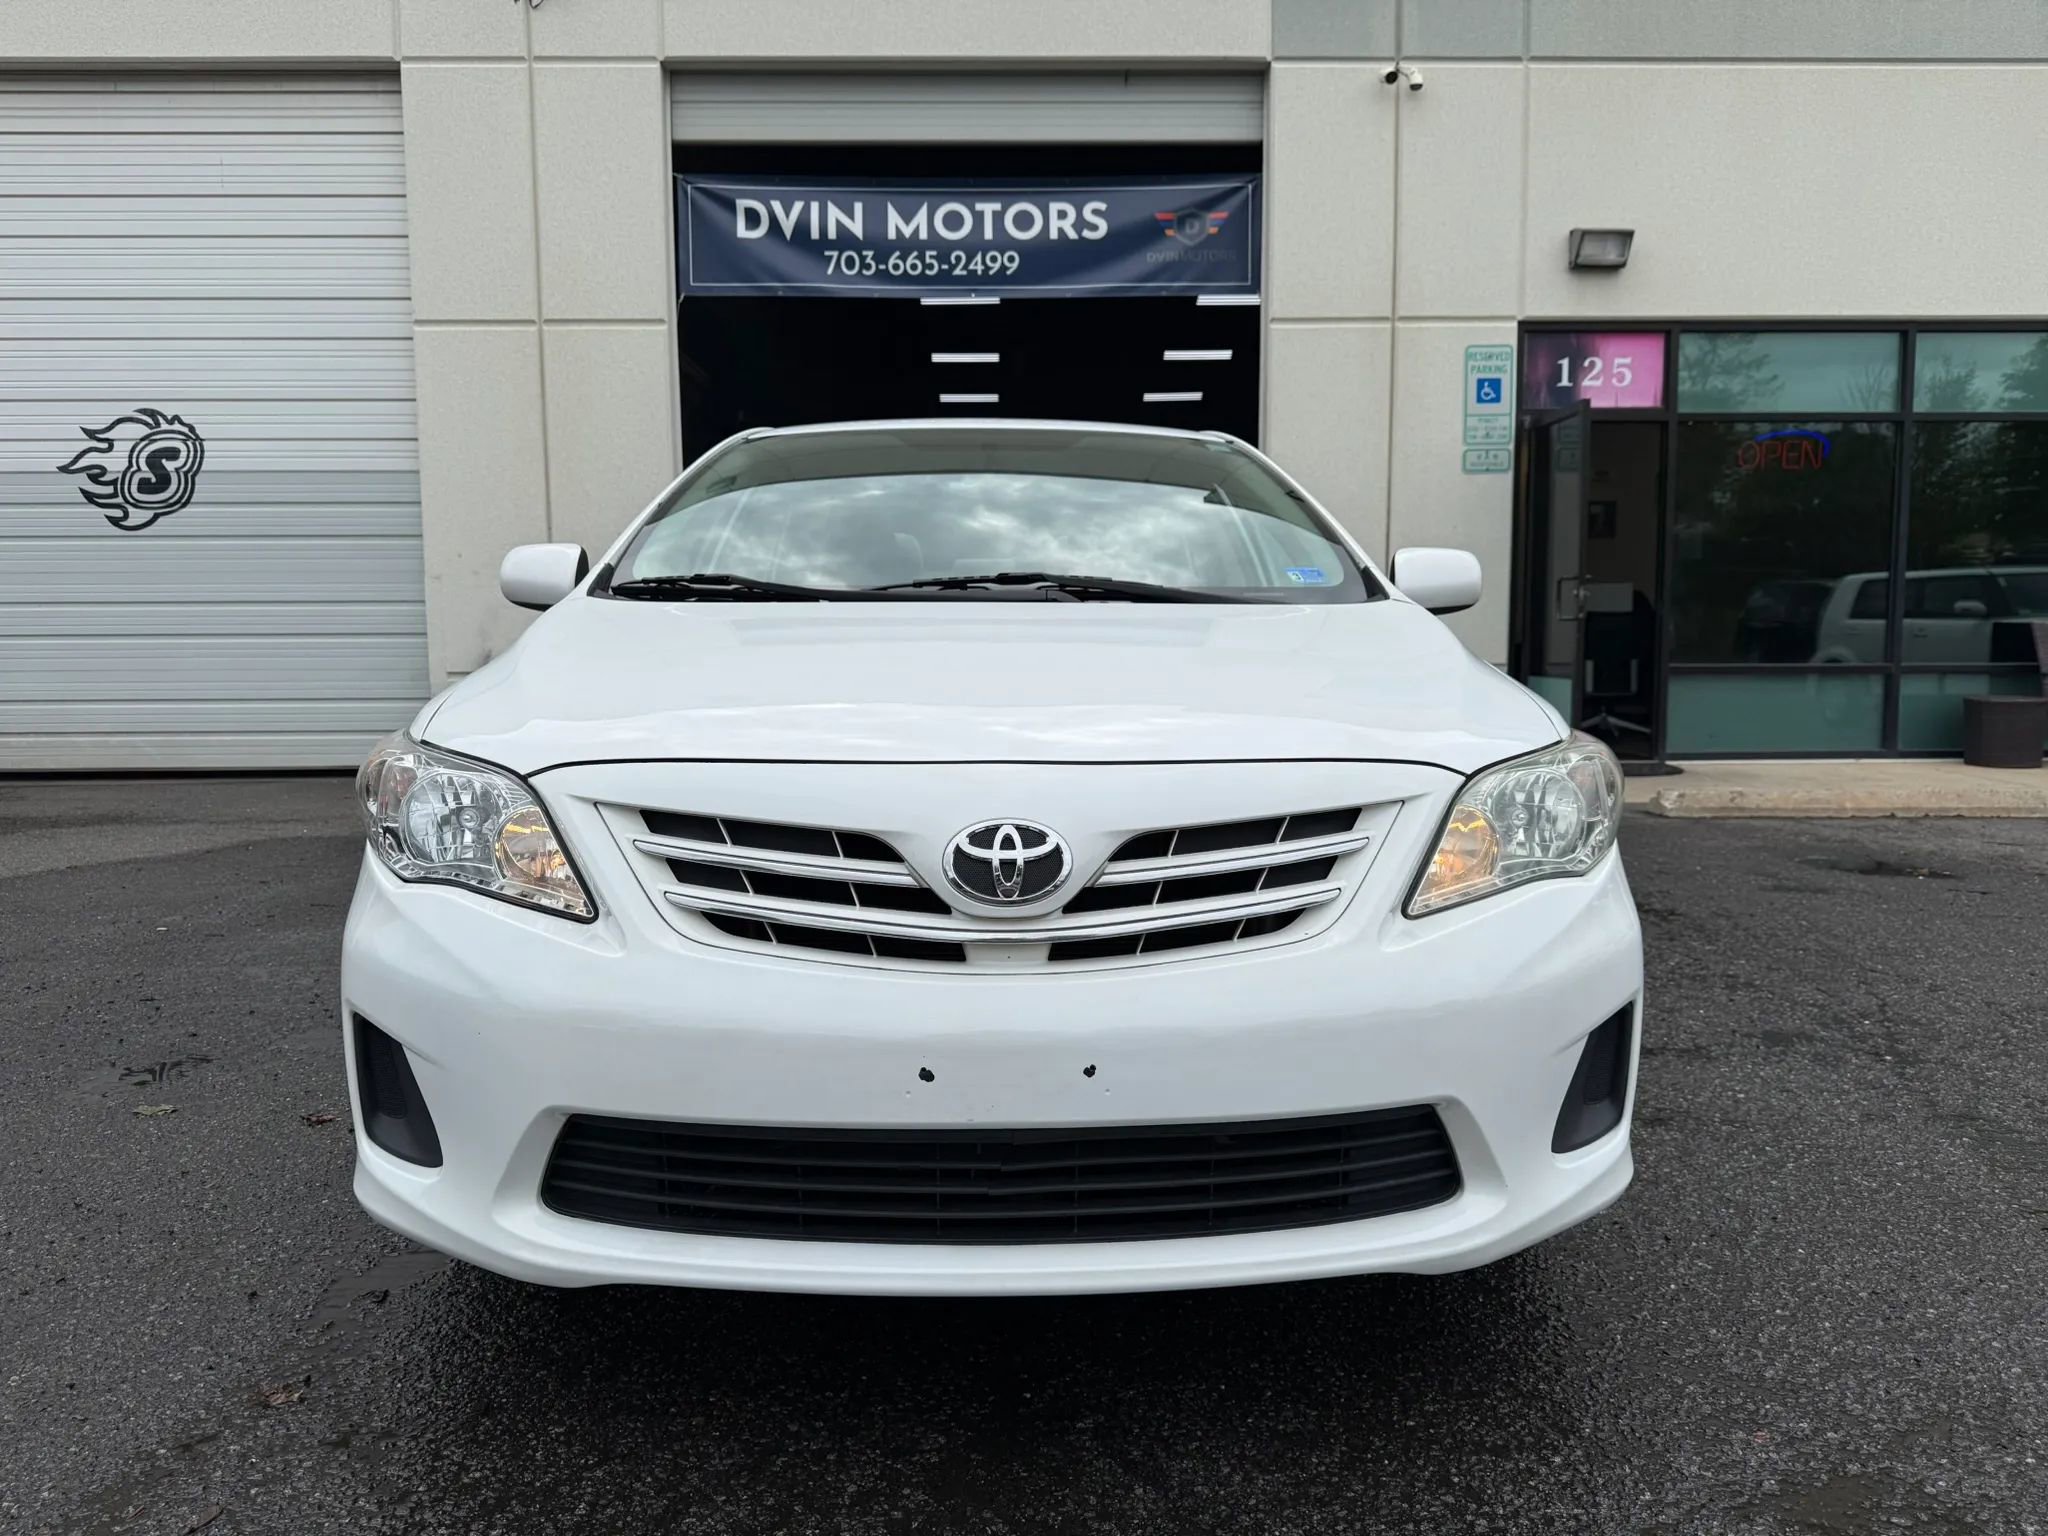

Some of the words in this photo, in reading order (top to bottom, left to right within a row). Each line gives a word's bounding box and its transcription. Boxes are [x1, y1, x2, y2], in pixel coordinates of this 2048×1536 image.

[735, 198, 863, 241] DVIN
[887, 201, 1109, 241] MOTORS
[823, 249, 1020, 277] 703-665-2499
[1469, 351, 1511, 362] RESERVED
[1470, 364, 1508, 374] PARKING
[1556, 356, 1632, 388] 125
[1737, 439, 1823, 470] OPEN
